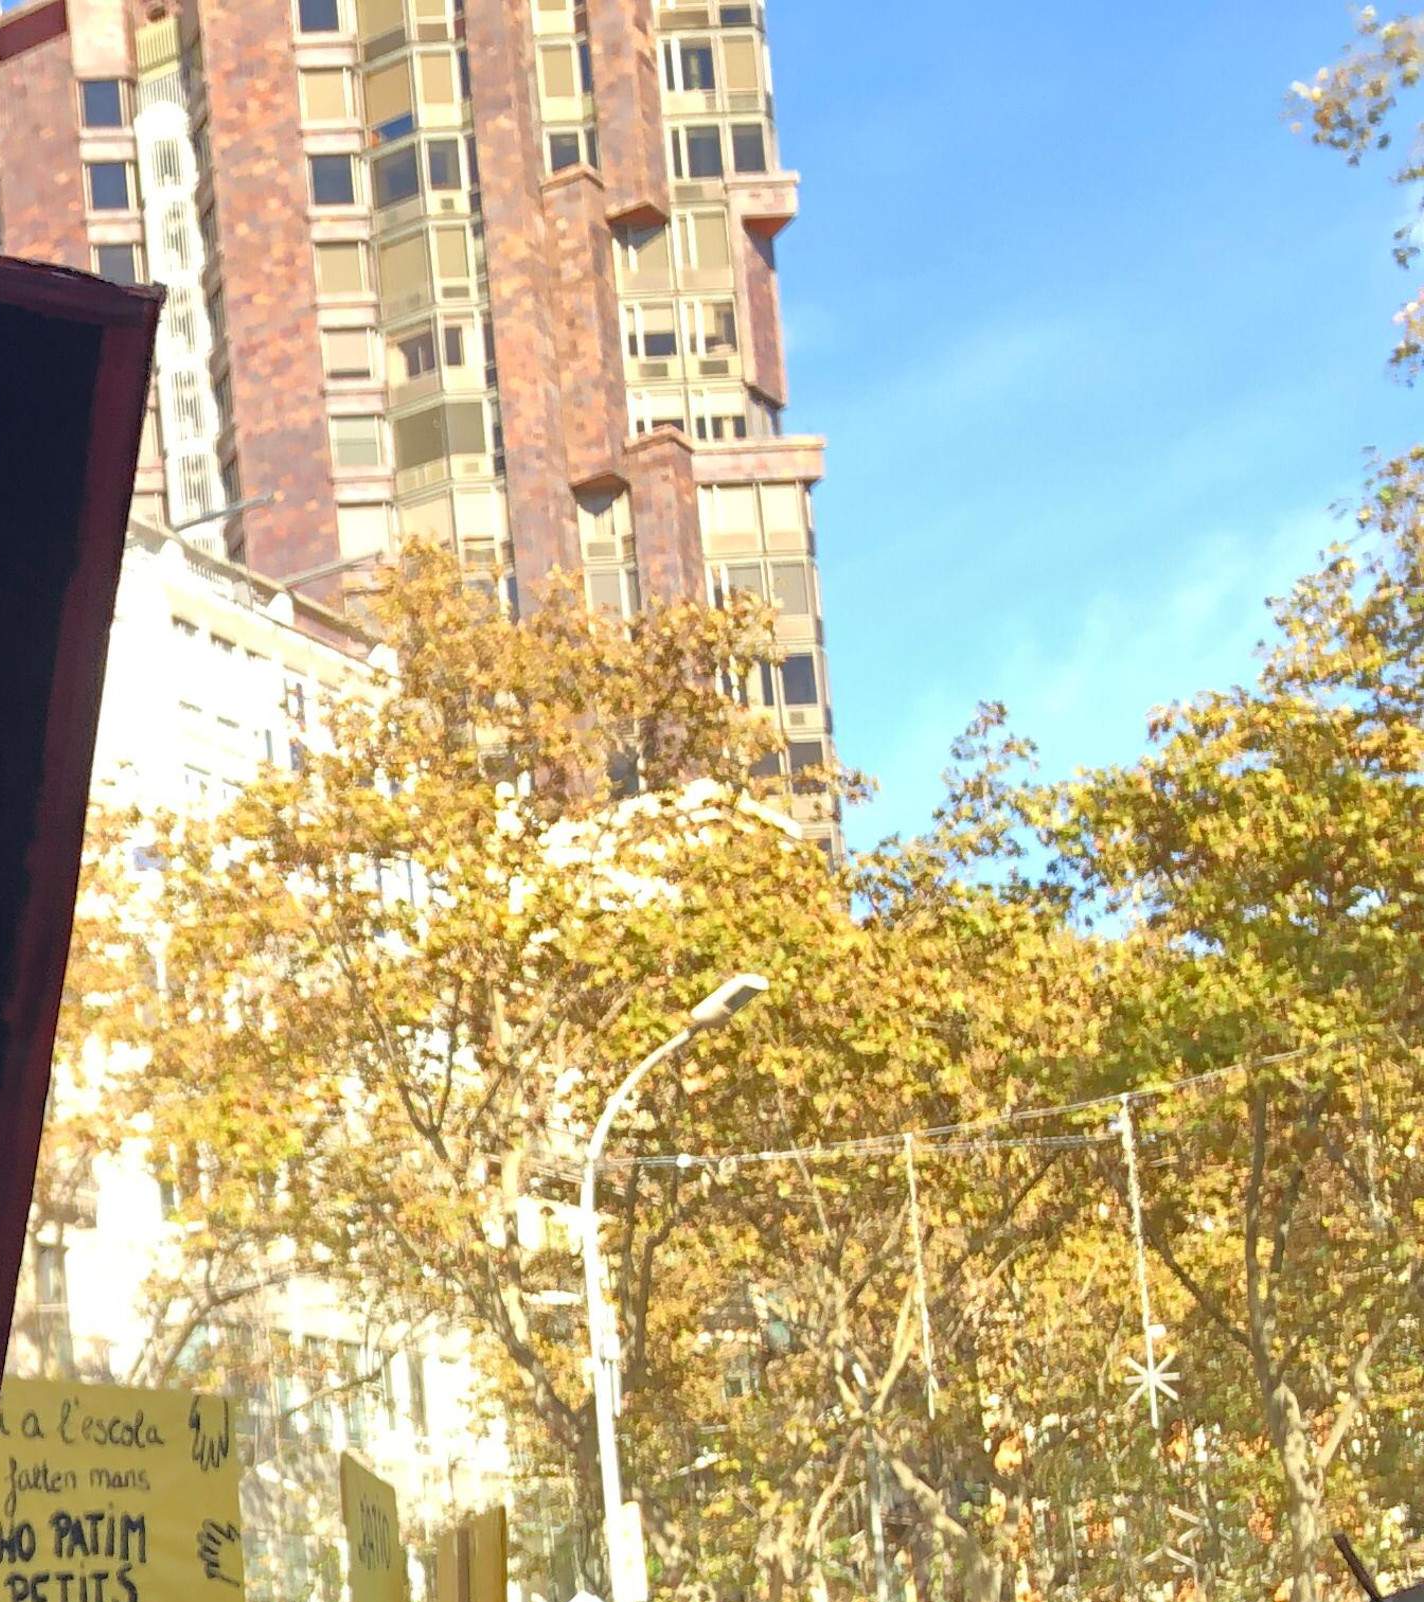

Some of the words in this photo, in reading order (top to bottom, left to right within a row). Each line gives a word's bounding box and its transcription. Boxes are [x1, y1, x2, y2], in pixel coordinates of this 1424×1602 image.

[21, 1408, 45, 1439] a
[57, 1395, 165, 1449] l'escola
[89, 1466, 151, 1491] mans
